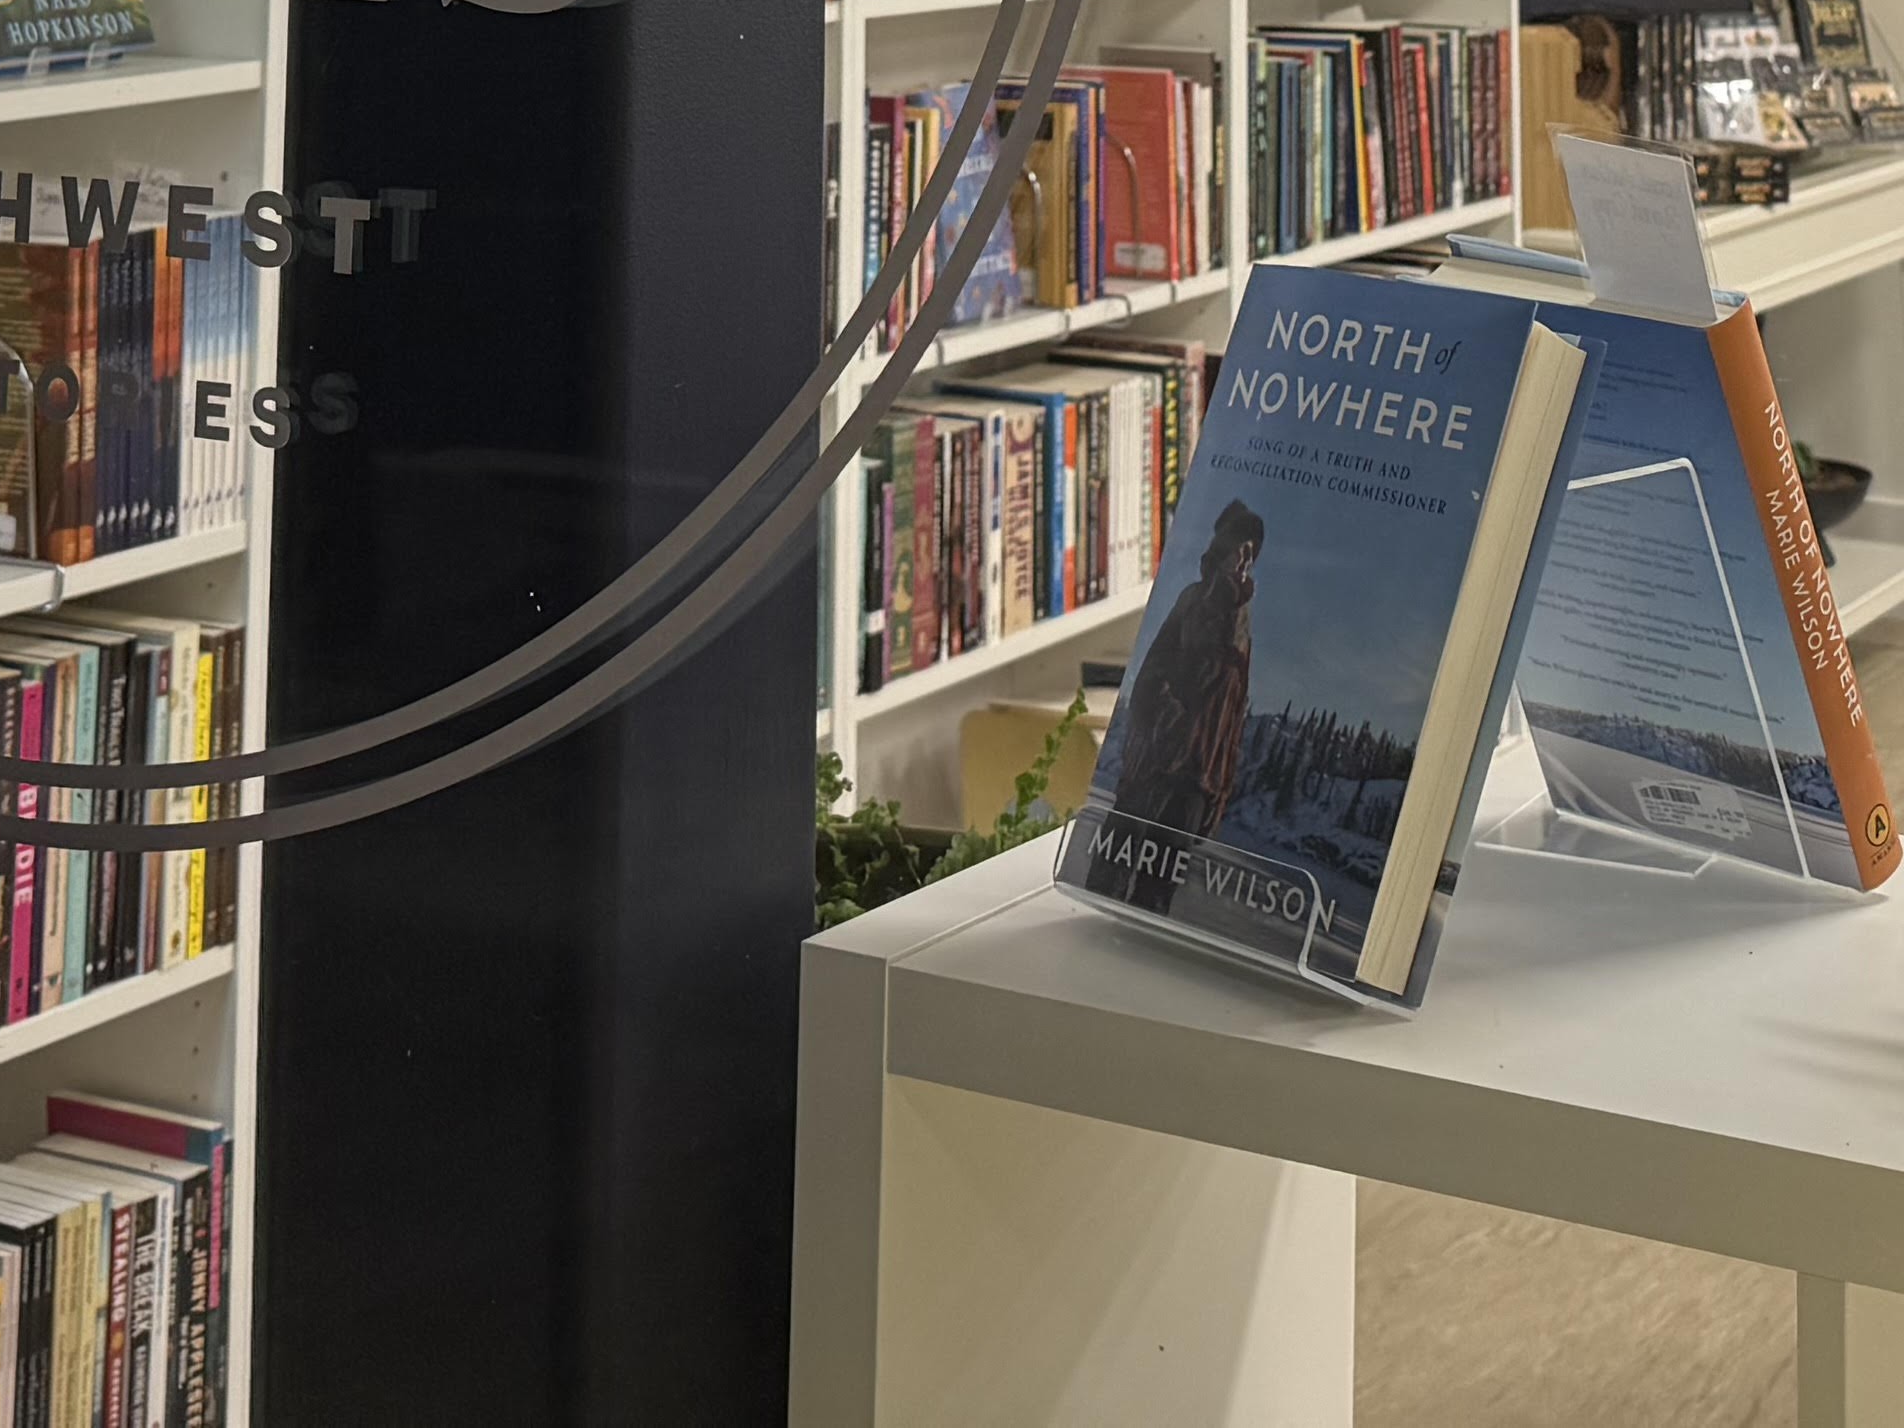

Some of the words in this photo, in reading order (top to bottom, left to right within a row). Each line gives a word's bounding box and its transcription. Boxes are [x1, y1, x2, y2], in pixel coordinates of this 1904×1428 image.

[6, 10, 135, 45] HOPKINSON
[1266, 309, 1432, 374] NORTH
[1433, 341, 1462, 375] of
[1165, 379, 1178, 441] LAST
[1228, 369, 1473, 451] NOWHERE
[1014, 455, 1032, 522] JAMES
[1164, 447, 1178, 505] MAN
[1210, 454, 1324, 489] RECONCILIATION
[1326, 477, 1448, 516] COMMISSIONER
[1247, 436, 1283, 455] SONG
[1287, 443, 1307, 458] OF
[1310, 447, 1321, 462] A
[1326, 451, 1374, 474] TRUTH
[1377, 464, 1412, 482] AND
[1763, 399, 1804, 514] NORTH
[1014, 537, 1032, 600] JOYCE
[1798, 518, 1823, 560] OF
[1765, 487, 1802, 570] MARIE
[1787, 576, 1830, 671] WILSON
[1809, 565, 1864, 729] NOWHERE
[1087, 823, 1192, 885] MARIE
[1203, 858, 1336, 933] WILSON
[111, 1213, 130, 1323] STEALING
[134, 1233, 158, 1270] THE
[191, 1247, 207, 1312] JONNY
[131, 1272, 157, 1337] BREAK
